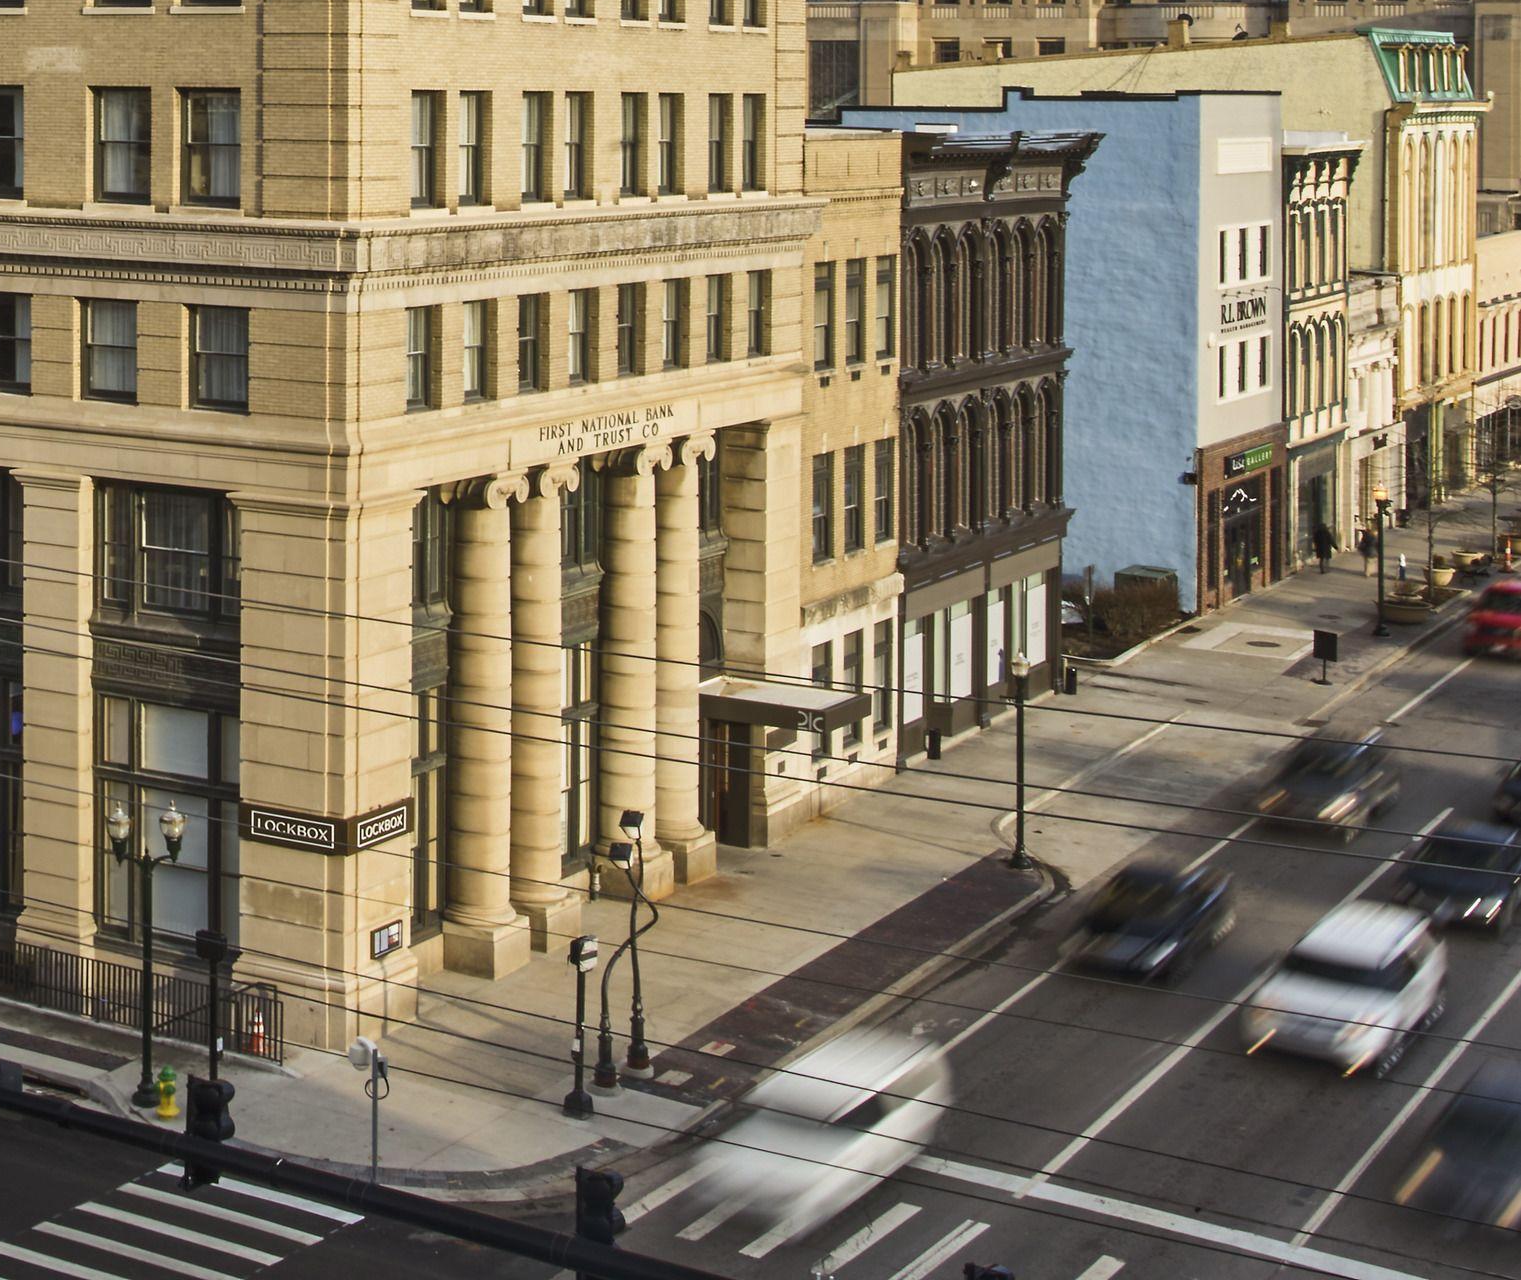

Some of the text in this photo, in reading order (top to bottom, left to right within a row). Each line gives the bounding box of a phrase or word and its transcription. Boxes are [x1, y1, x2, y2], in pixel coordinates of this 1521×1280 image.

[1237, 296, 1266, 322] BROWN
[539, 404, 674, 442] FIRST NATIONAL BANK
[558, 422, 659, 456] AND TRUST CO
[1246, 449, 1273, 466] GALLERY
[257, 817, 329, 842] LOCKBOX
[360, 814, 403, 841] LOCKBOX
